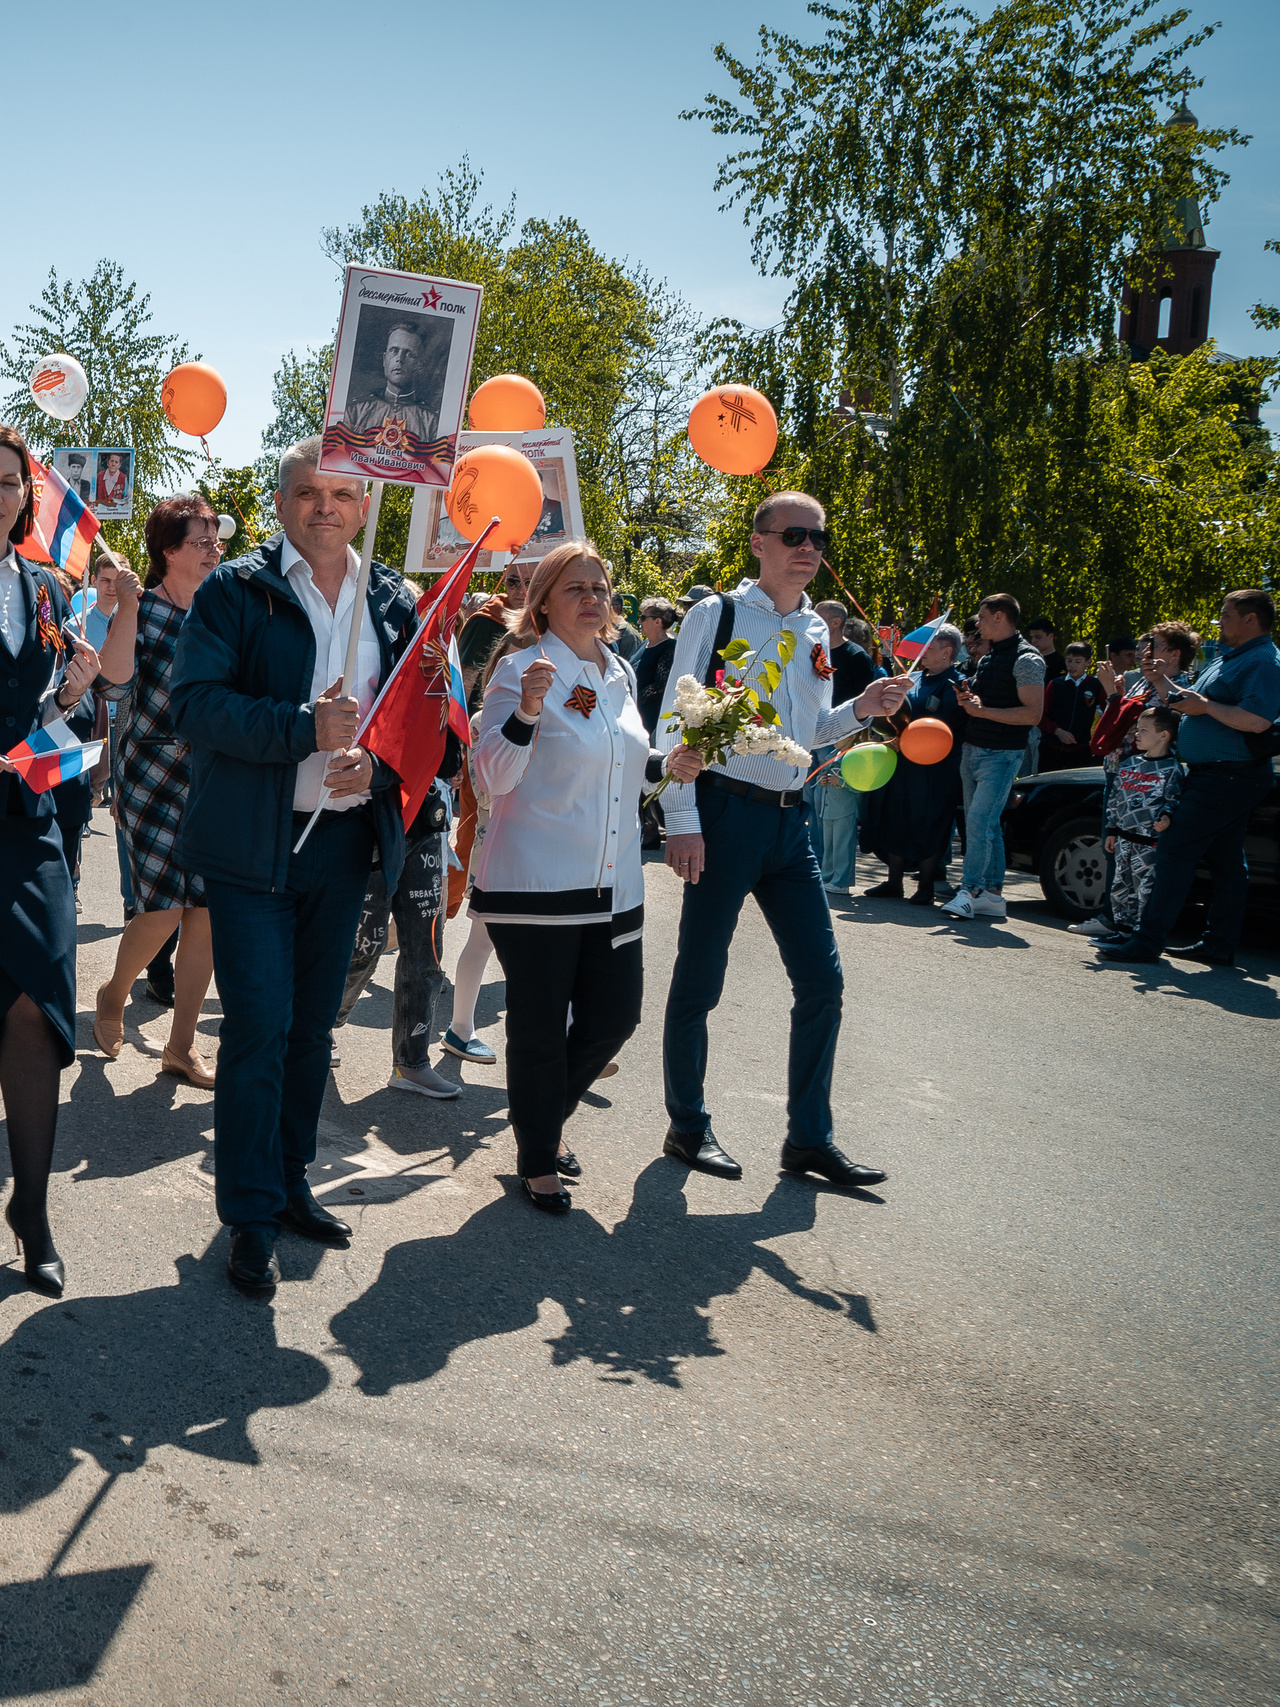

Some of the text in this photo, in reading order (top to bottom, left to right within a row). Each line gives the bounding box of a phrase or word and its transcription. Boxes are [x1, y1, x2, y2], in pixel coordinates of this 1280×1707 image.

[376, 445, 403, 459] Швец
[350, 452, 425, 471] Иван Иванович
[1120, 769, 1164, 784] STREET
[1121, 781, 1151, 793] RACE
[409, 889, 434, 899] BREAK
[417, 900, 430, 909] THE
